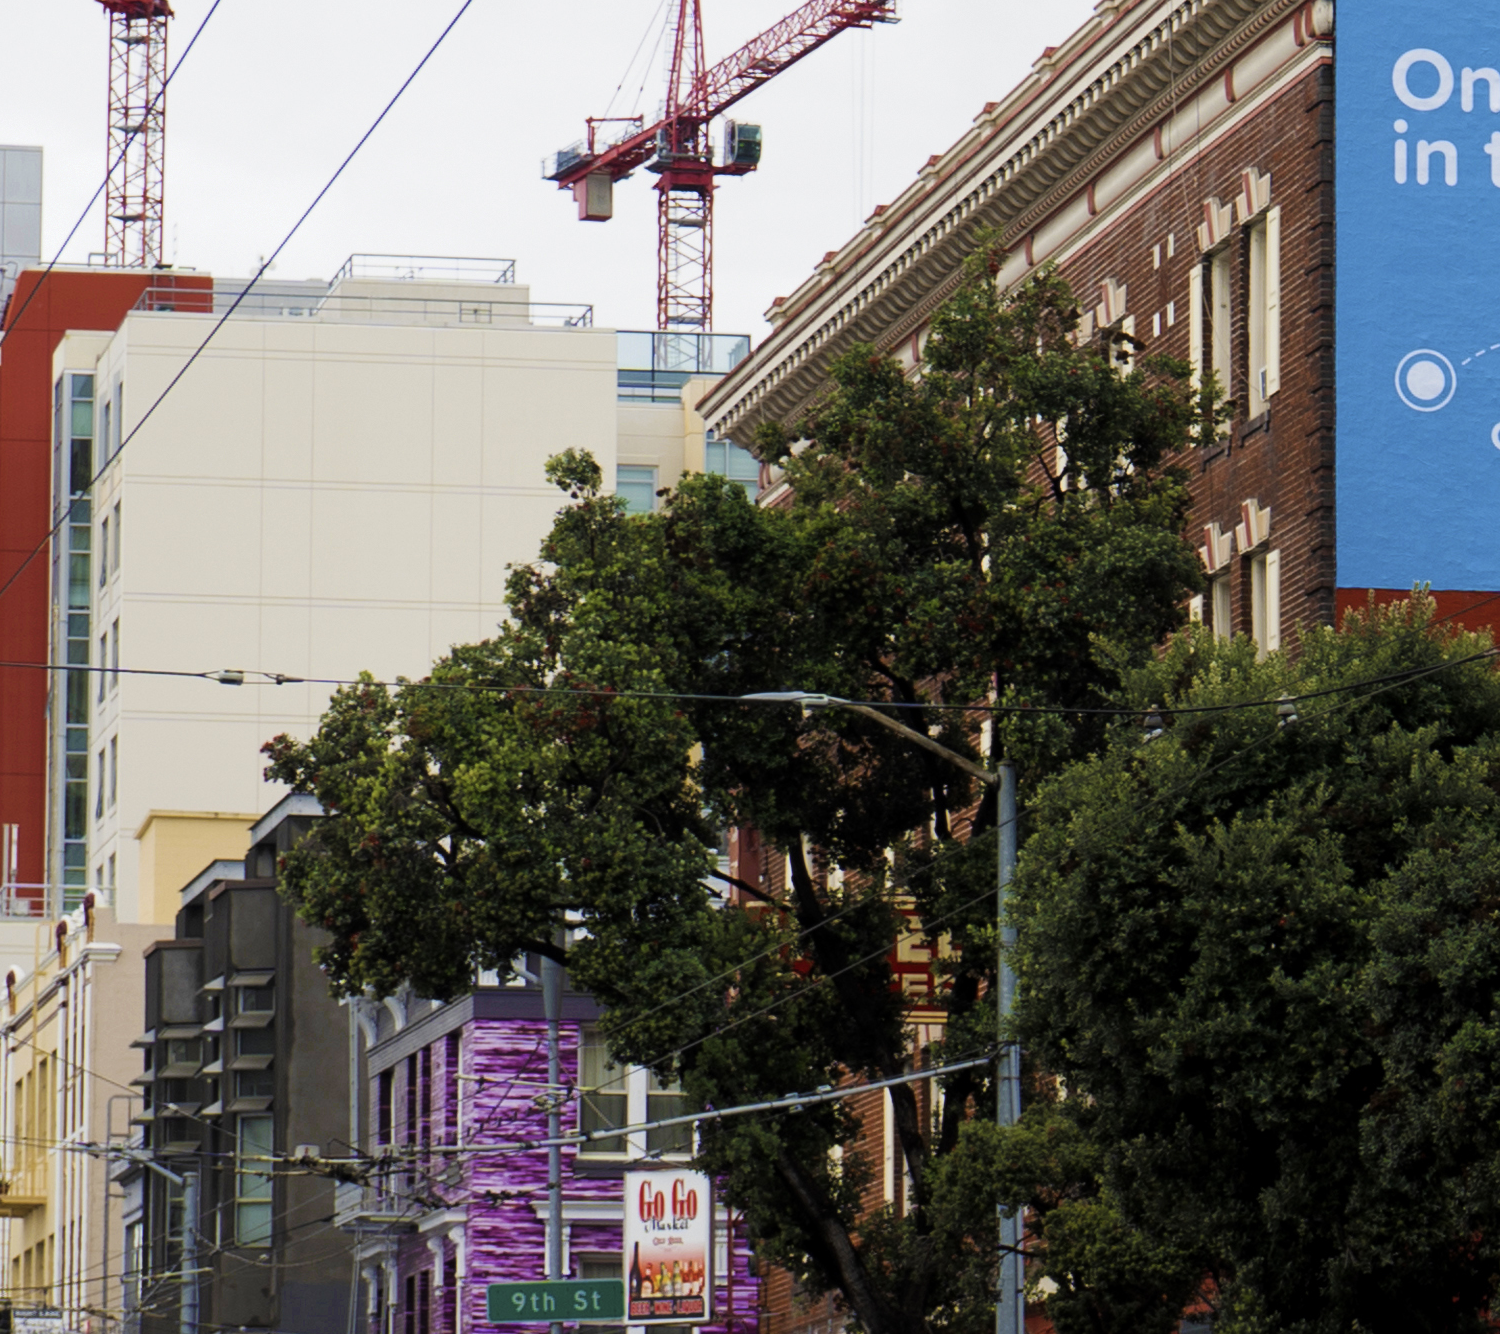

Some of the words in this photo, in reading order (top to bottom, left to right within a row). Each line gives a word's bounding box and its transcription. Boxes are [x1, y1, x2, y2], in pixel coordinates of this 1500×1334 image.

[1393, 118, 1459, 187] in
[639, 1180, 665, 1223] Go
[672, 1178, 698, 1221] Go
[511, 1291, 556, 1313] 9th
[573, 1290, 601, 1311] St
